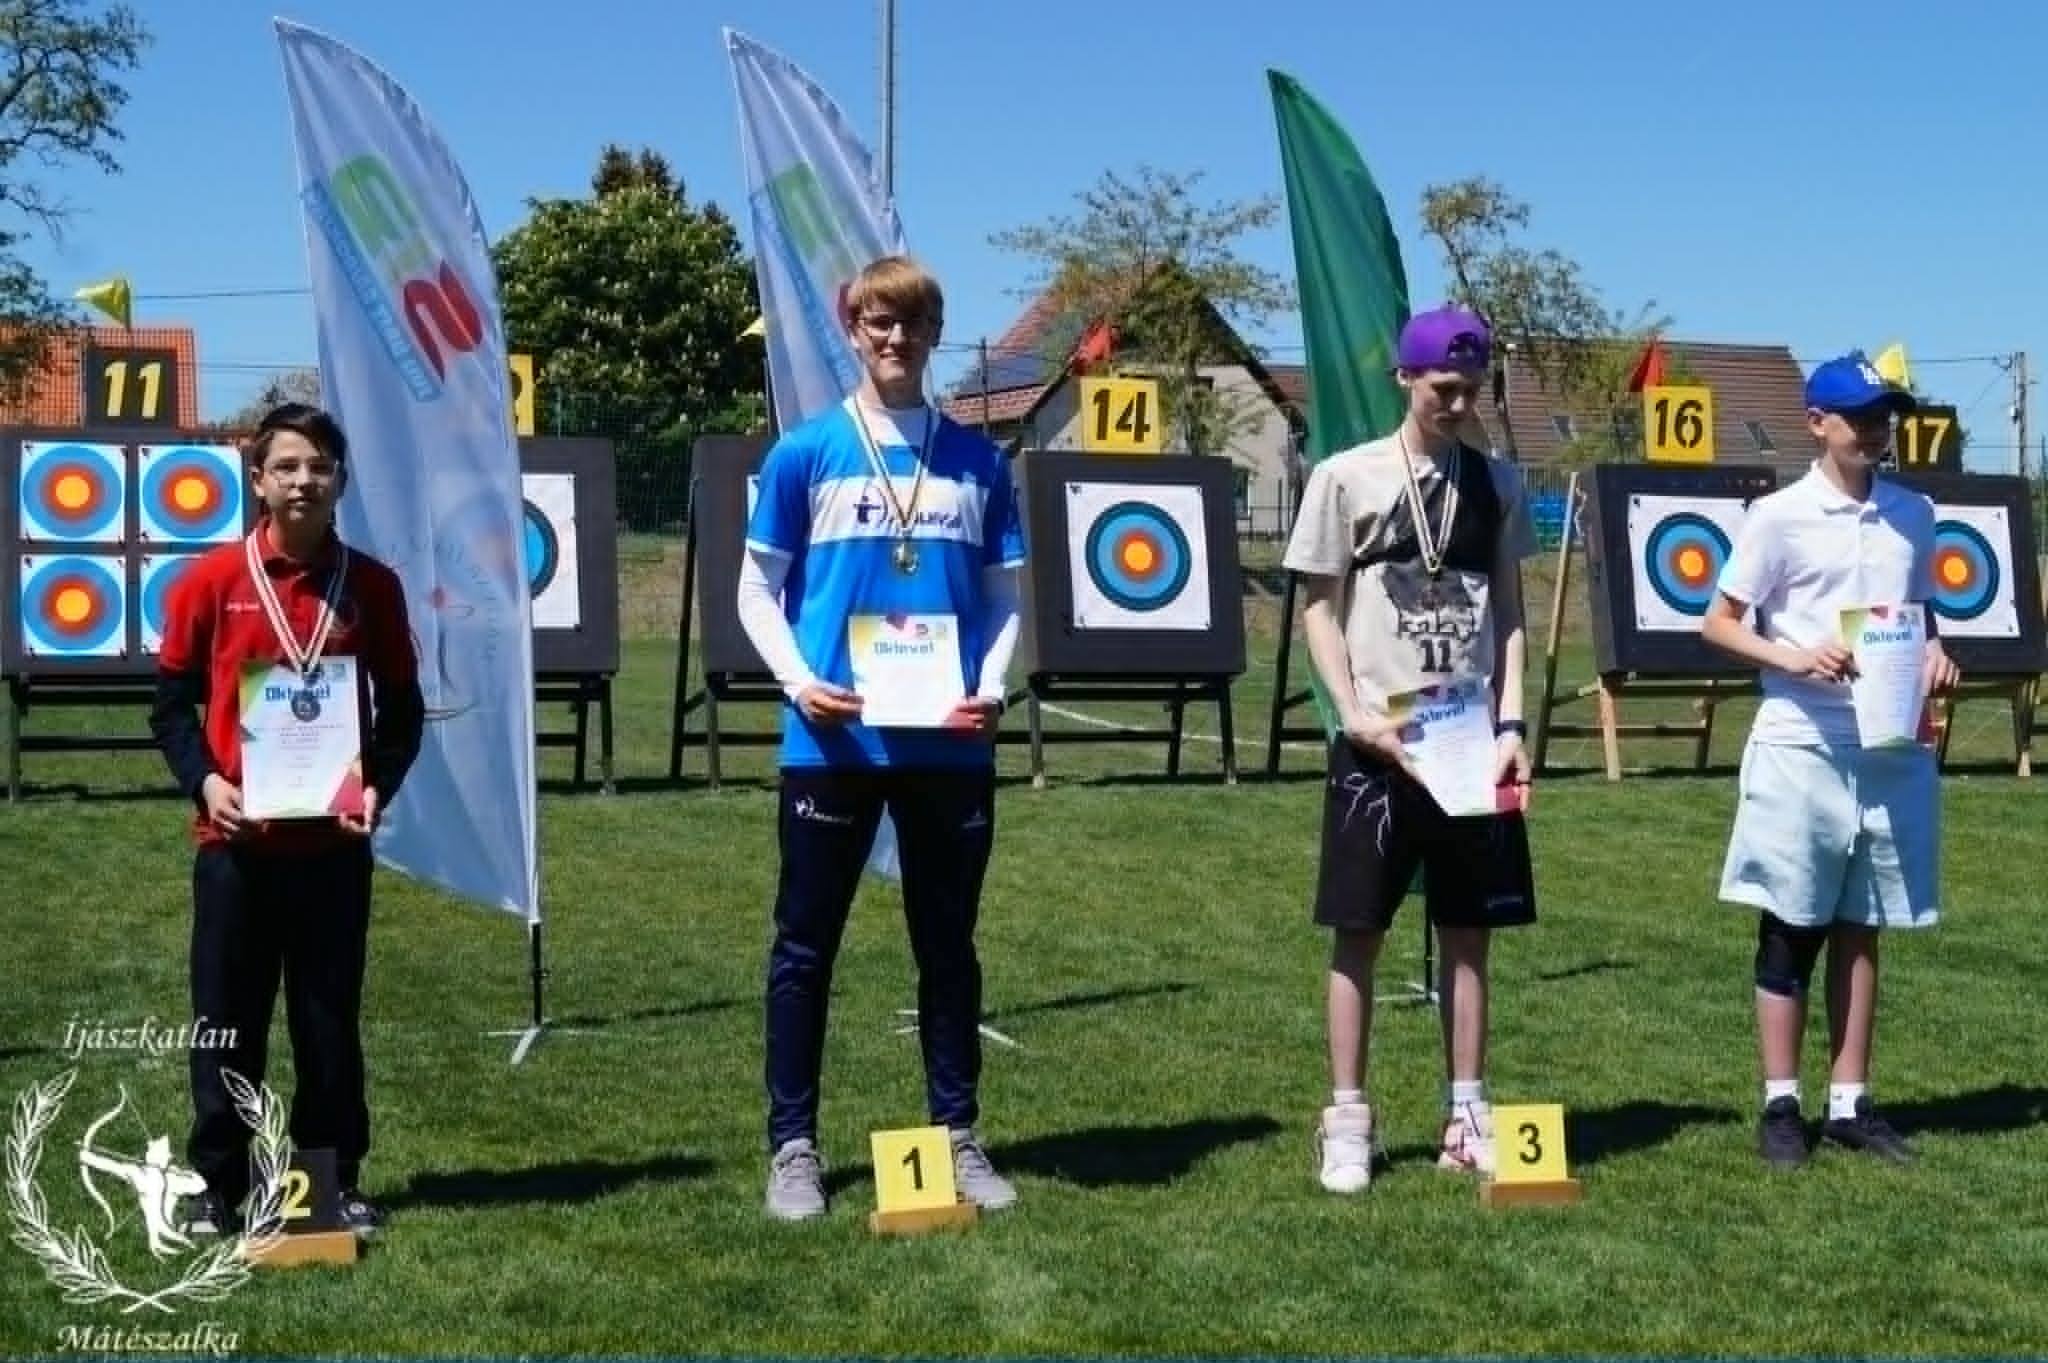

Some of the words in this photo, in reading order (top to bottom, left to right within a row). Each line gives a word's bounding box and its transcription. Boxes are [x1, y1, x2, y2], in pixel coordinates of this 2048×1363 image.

[104, 361, 161, 418] 11
[1093, 389, 1151, 442] 14
[1655, 399, 1703, 448] 16
[1904, 416, 1951, 464] 17
[1420, 639, 1454, 673] 11
[1518, 1122, 1543, 1166] 3
[902, 1146, 924, 1192] 1
[280, 1169, 312, 1219] 2
